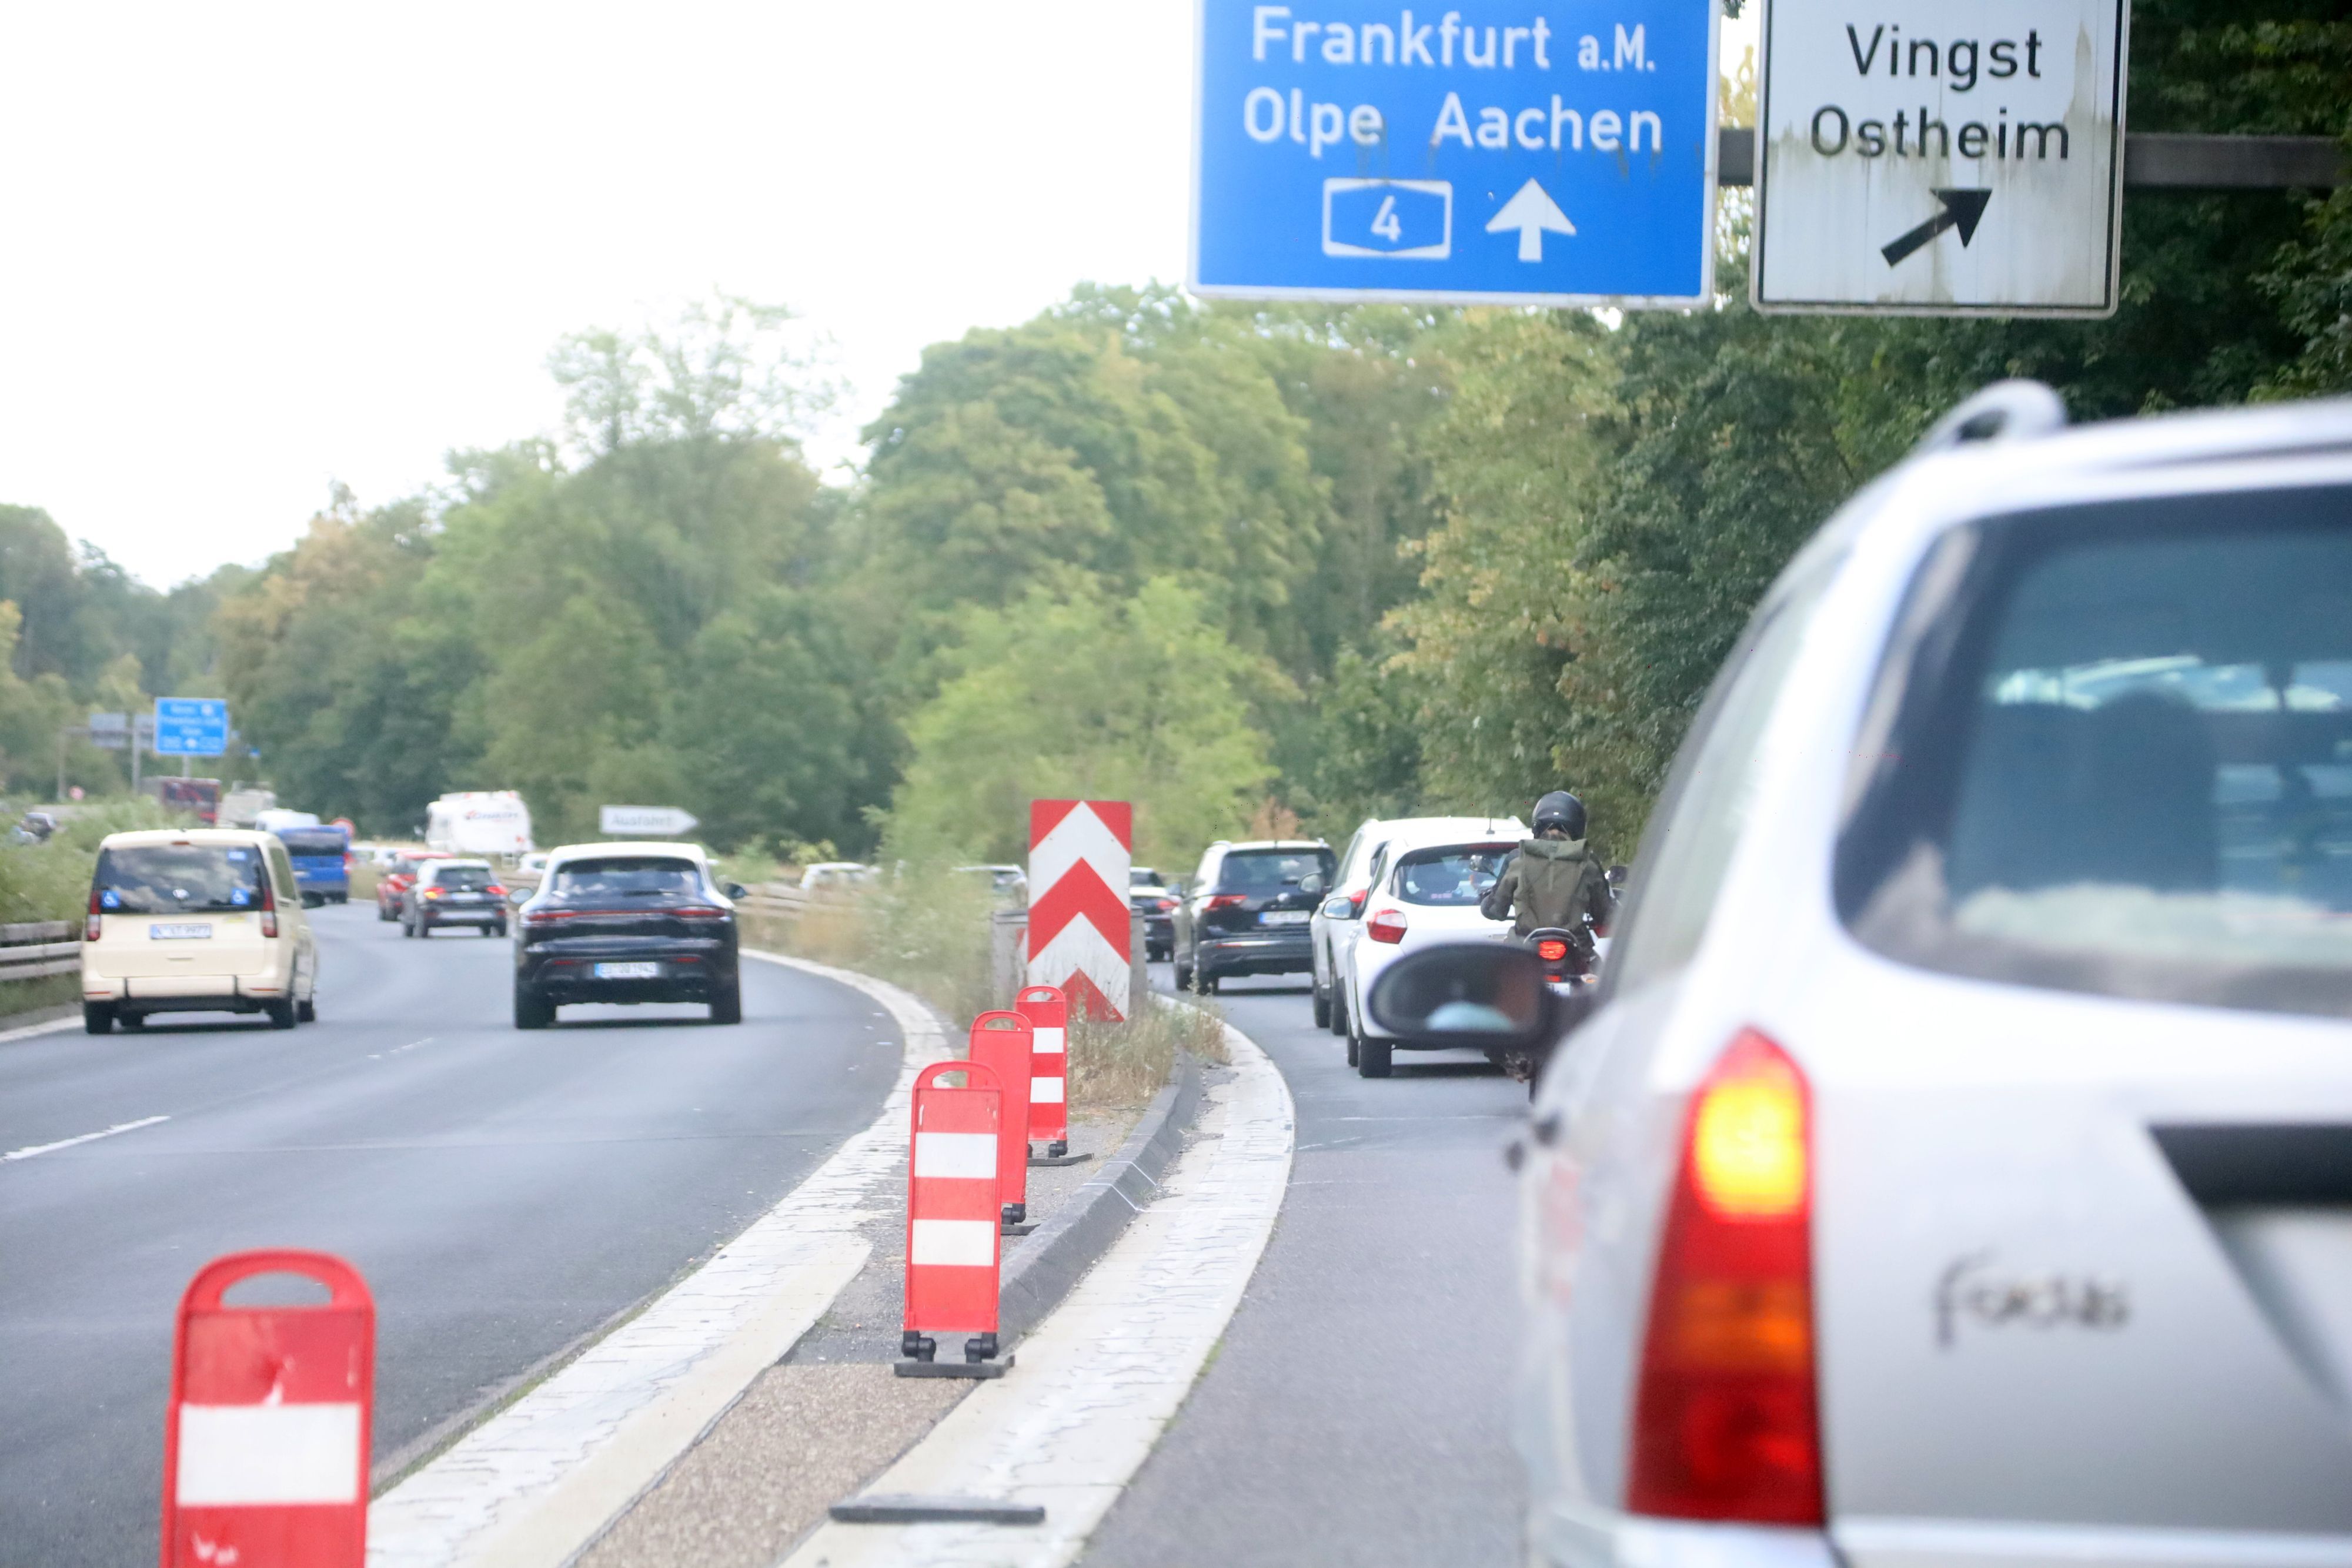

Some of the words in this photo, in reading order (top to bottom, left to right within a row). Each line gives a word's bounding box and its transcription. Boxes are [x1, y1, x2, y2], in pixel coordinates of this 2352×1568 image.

[1252, 5, 1551, 69] Frankfurt
[1578, 24, 1655, 71] a.M.
[1846, 23, 2042, 92] Vingst
[1243, 86, 1385, 159] Olpe
[1431, 91, 1662, 152] Aachen
[1810, 104, 2069, 159] Ostheim
[1370, 195, 1402, 242] 4
